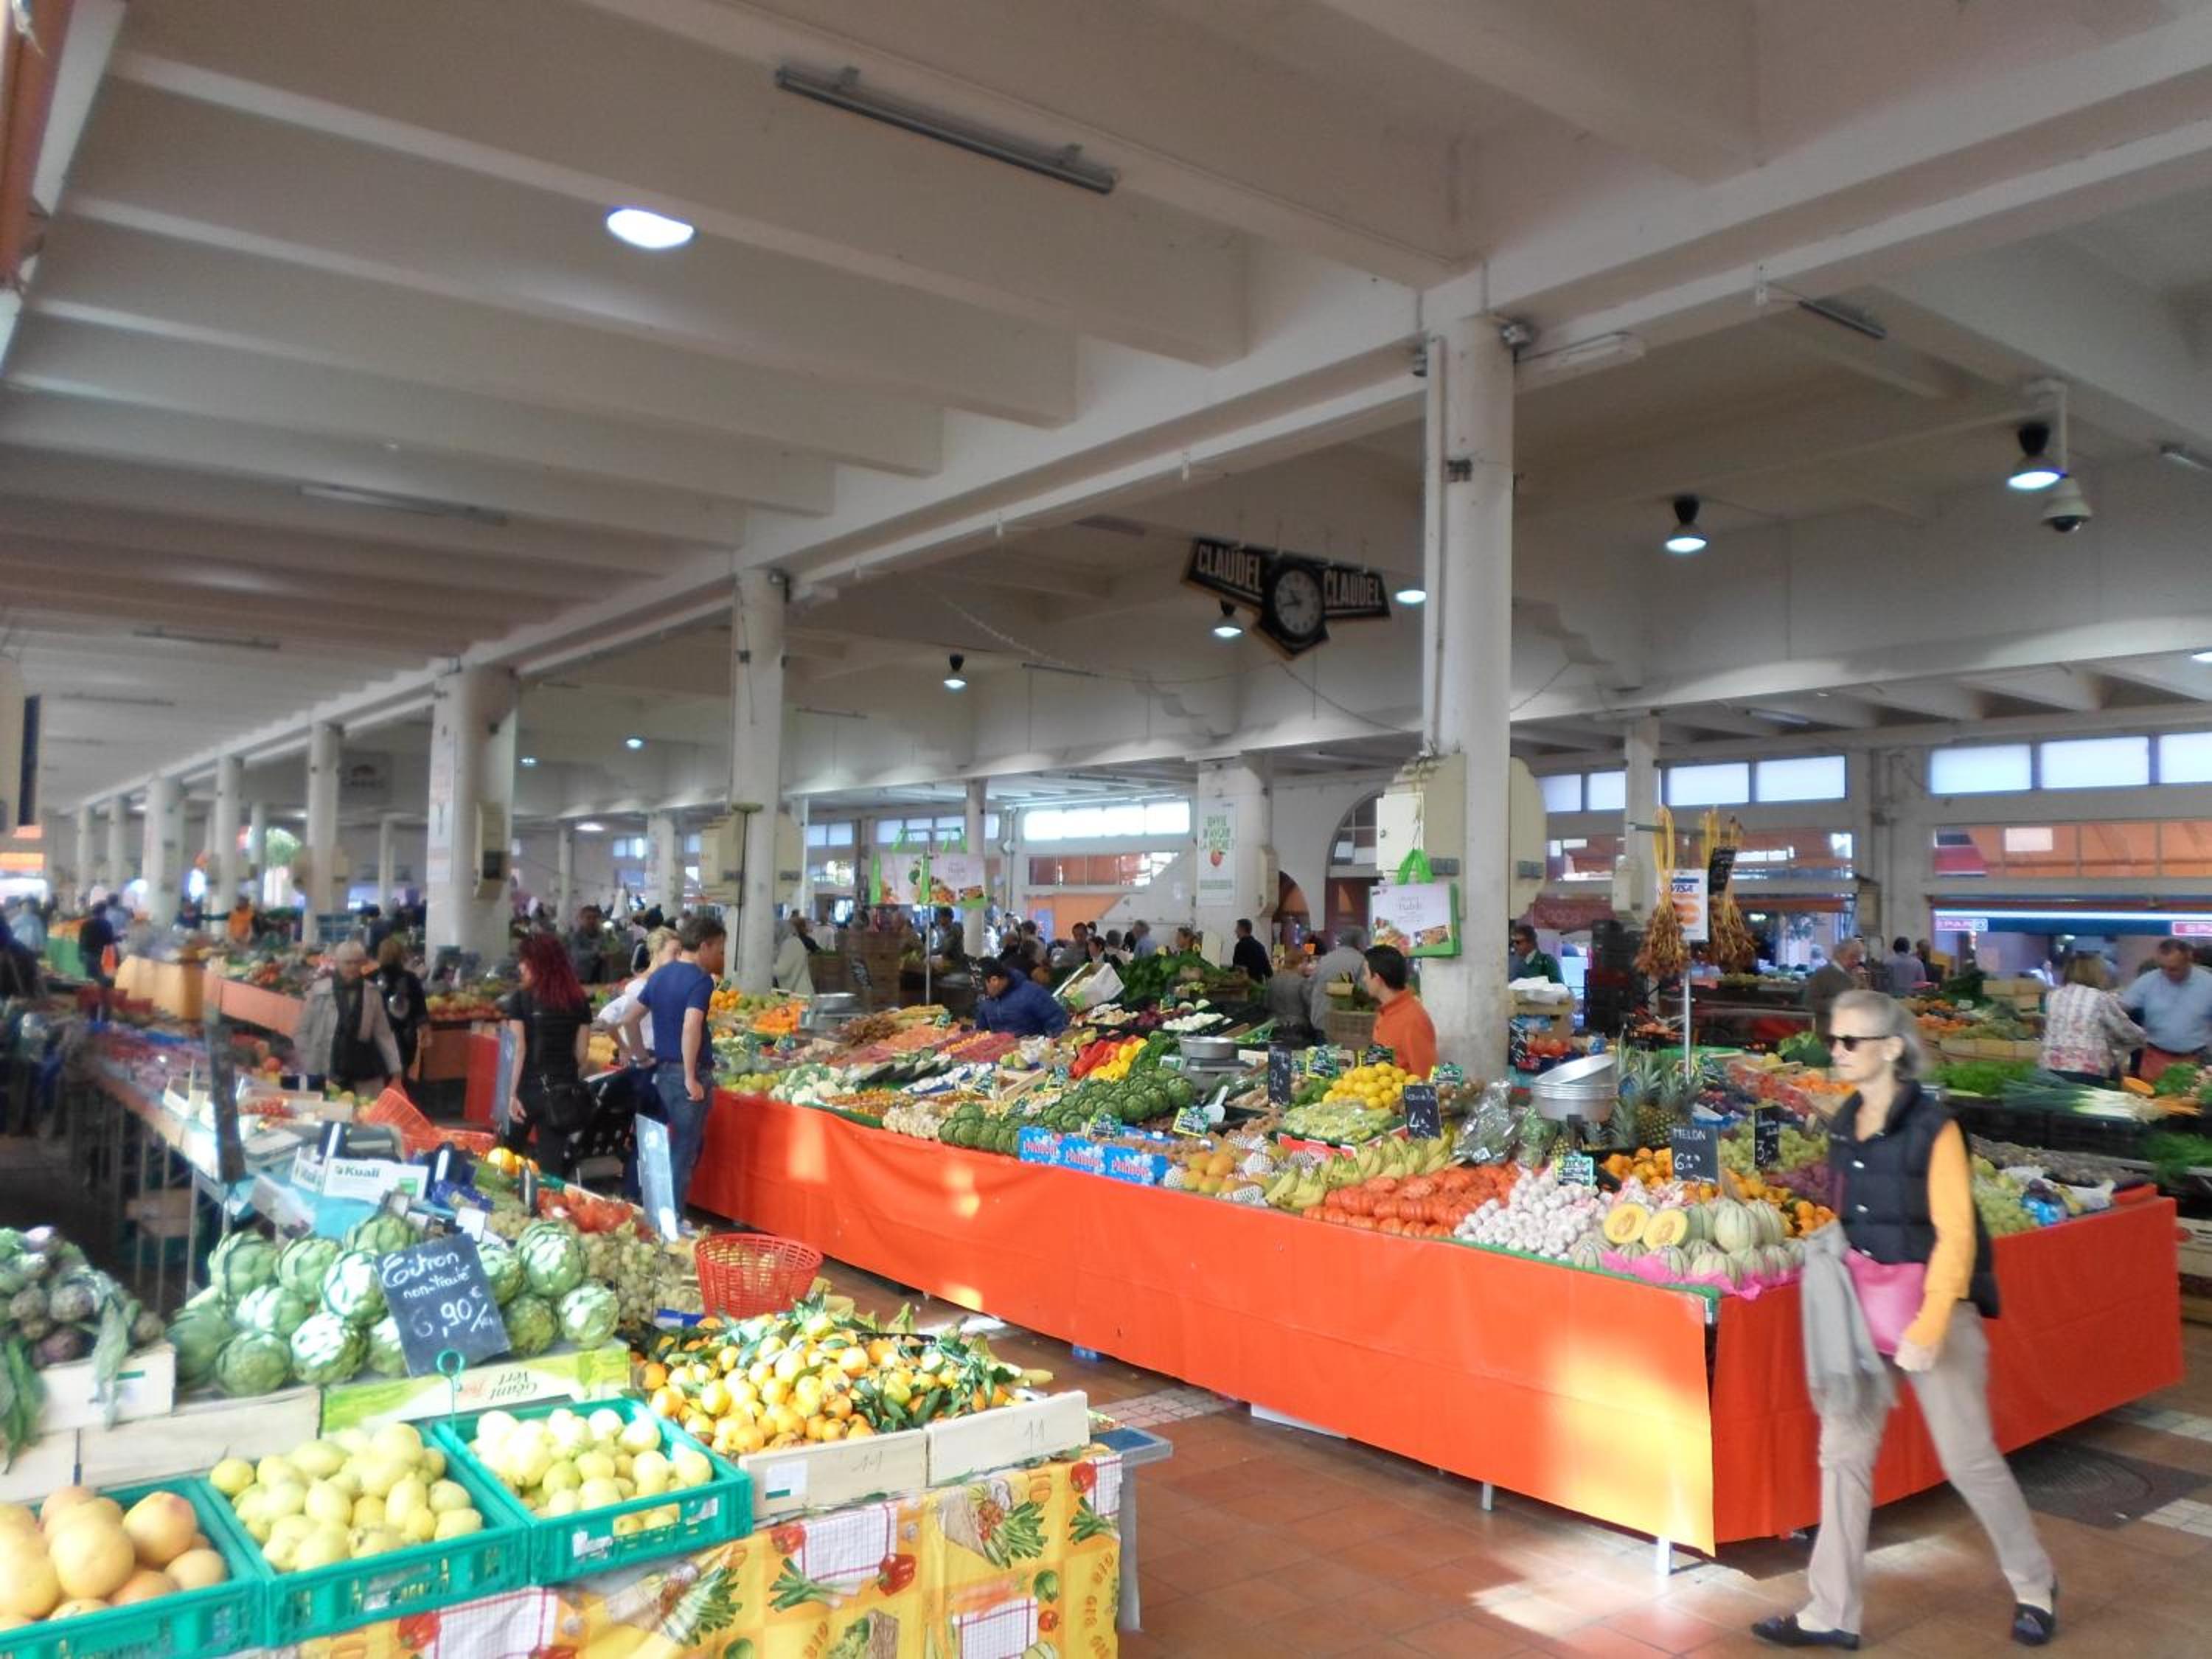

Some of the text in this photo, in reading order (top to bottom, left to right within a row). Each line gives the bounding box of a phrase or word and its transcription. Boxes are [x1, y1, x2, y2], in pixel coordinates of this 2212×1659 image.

[1197, 544, 1263, 591] CLAUDEL
[1324, 569, 1382, 608] CLAUDEL
[1673, 1127, 1706, 1140] MELON
[382, 1252, 459, 1288] Citron
